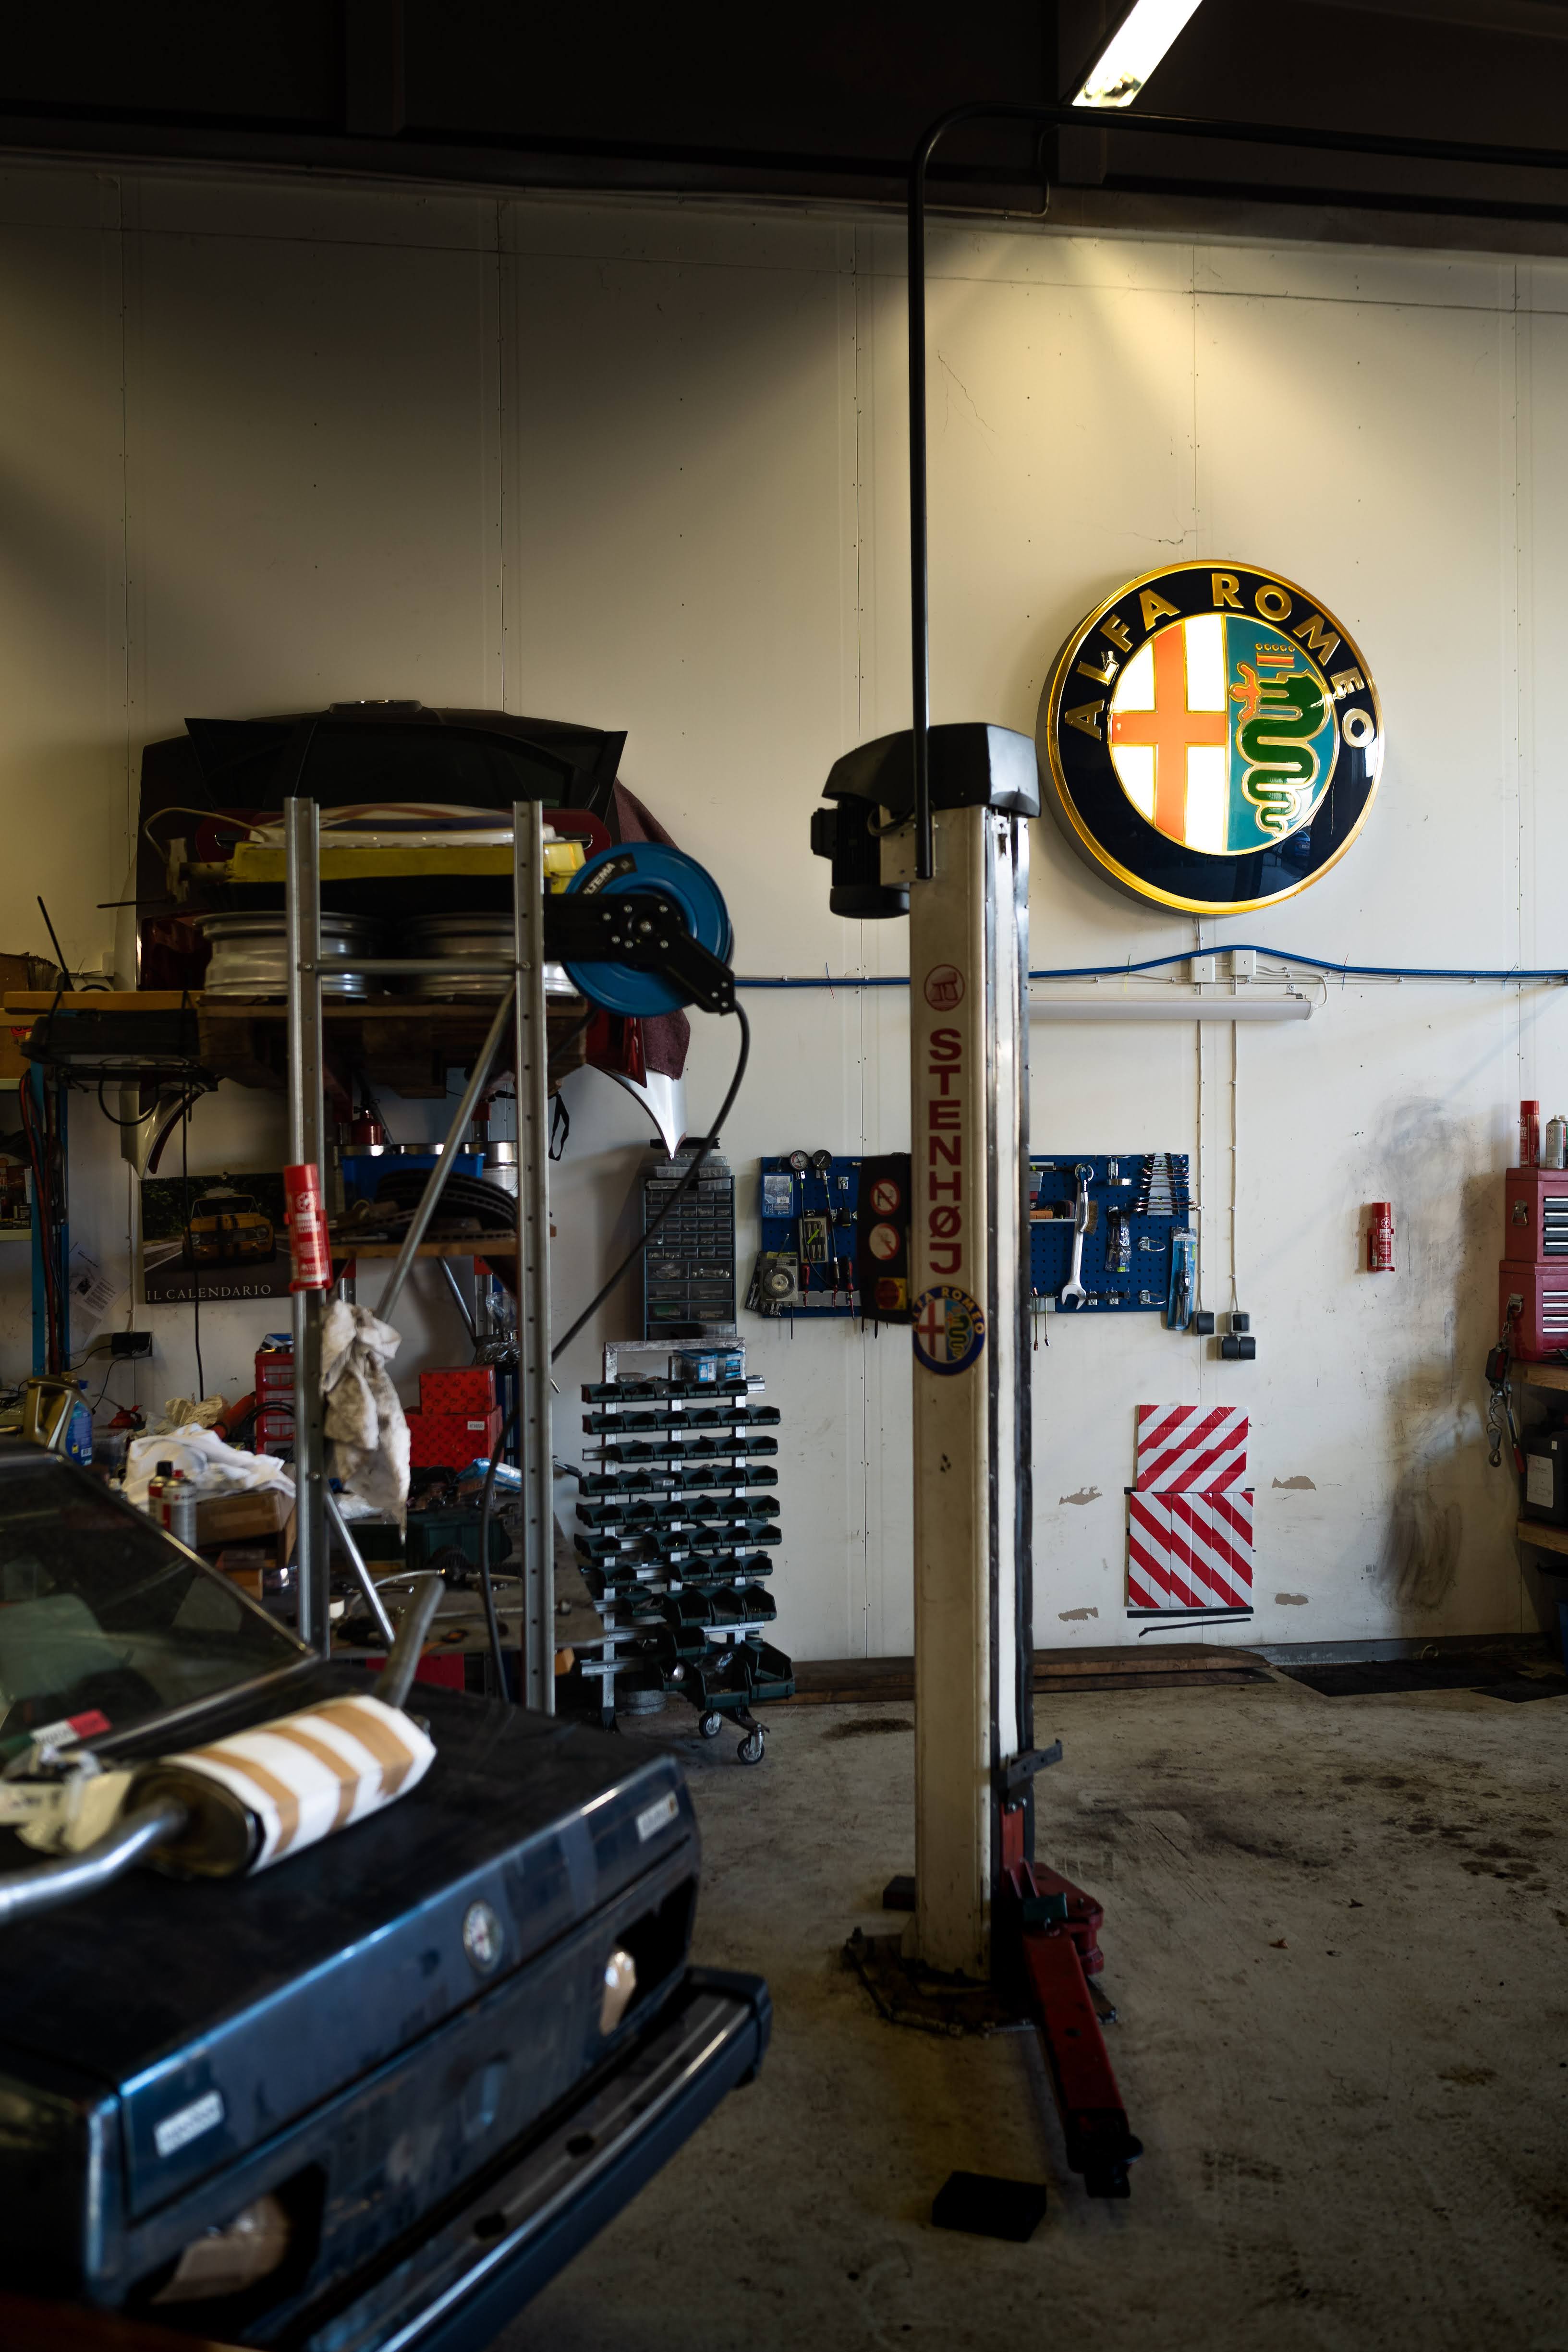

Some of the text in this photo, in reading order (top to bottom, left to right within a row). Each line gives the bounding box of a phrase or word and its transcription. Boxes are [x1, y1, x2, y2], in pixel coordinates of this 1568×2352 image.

[1065, 573, 1375, 749] ALFA ROMEO
[928, 1028, 963, 1275] STENHØJ
[146, 1285, 271, 1301] IL CALENDARIO
[941, 1286, 985, 1335] ROMEO
